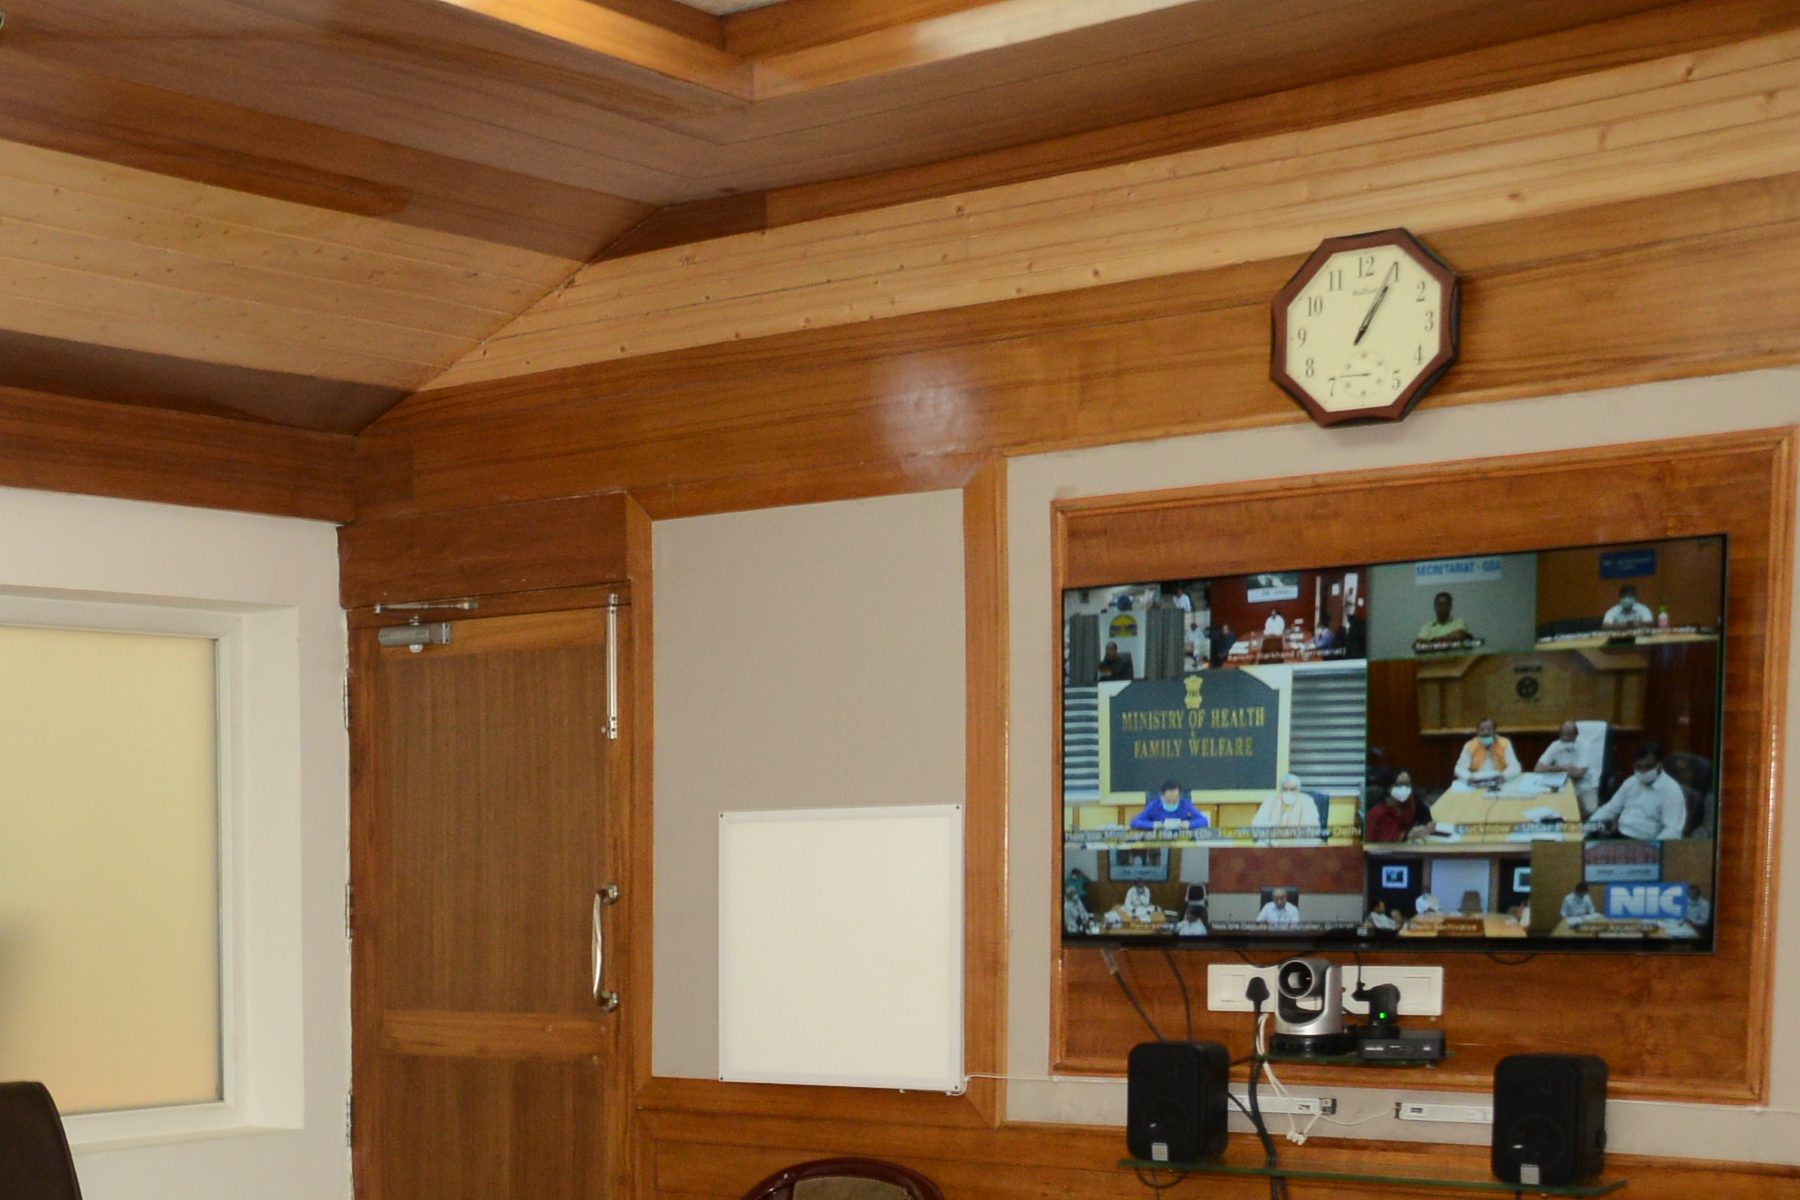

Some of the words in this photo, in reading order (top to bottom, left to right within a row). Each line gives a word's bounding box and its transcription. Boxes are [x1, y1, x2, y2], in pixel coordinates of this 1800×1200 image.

[1357, 256, 1374, 278] 12
[1328, 270, 1343, 292] 11
[1416, 282, 1426, 302] 2
[1307, 296, 1323, 317] 10
[1425, 311, 1434, 332] 3
[1297, 329, 1306, 348] 9
[1413, 345, 1422, 365] 4
[1305, 359, 1314, 378] 8
[1328, 377, 1336, 397] 7
[1392, 370, 1401, 391] 5
[1122, 709, 1184, 731] MINISTRY
[1188, 709, 1206, 729] OF
[1211, 706, 1266, 728] HEALTH
[1134, 738, 1182, 758] FAMILY
[1188, 736, 1254, 757] WELFARE
[1609, 885, 1683, 916] NIC
